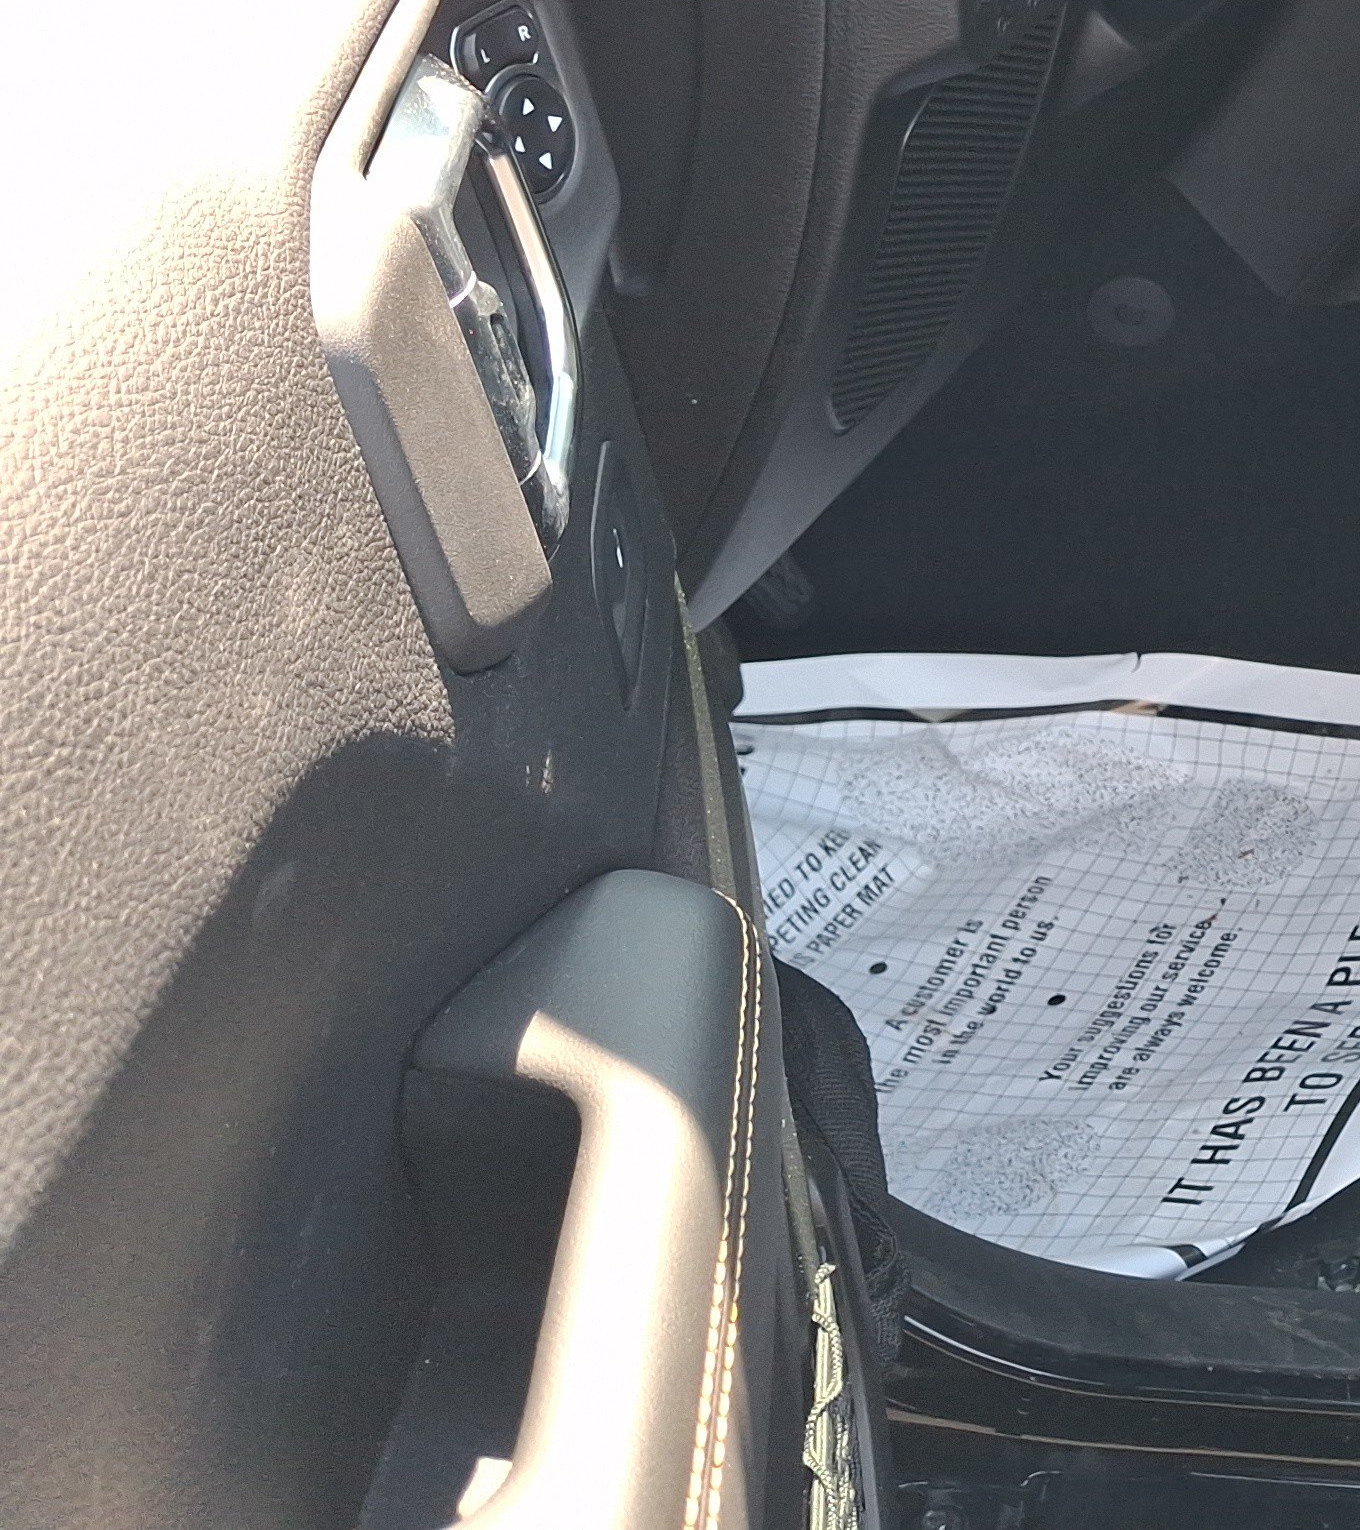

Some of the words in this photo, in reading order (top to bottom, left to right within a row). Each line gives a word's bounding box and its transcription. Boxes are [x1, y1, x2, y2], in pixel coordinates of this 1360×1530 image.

[480, 48, 491, 64] L
[517, 24, 532, 42] R
[795, 852, 823, 881] TO
[805, 903, 864, 955] PAPER
[855, 864, 895, 907] MAT
[829, 837, 883, 892] CLEAN
[885, 1018, 909, 1031] A
[901, 937, 968, 1017] customer
[956, 919, 984, 934] is
[902, 1018, 947, 1064] most
[937, 933, 1010, 1017] important
[1001, 876, 1053, 931] person
[931, 1050, 959, 1064] in
[949, 1020, 984, 1045] the
[977, 968, 1022, 1016] world
[1011, 947, 1037, 965] to
[1028, 916, 1059, 943] us.
[1038, 1047, 1083, 1082] Your
[1077, 949, 1160, 1043] suggestions
[1146, 922, 1177, 945] for
[1108, 1066, 1140, 1091] are
[1133, 1010, 1186, 1062] always
[1177, 926, 1243, 1008] welcome.
[1069, 1016, 1151, 1091] improving
[1140, 984, 1169, 1013] our
[1161, 1177, 1215, 1206] IT
[1190, 1096, 1266, 1165] HAS
[1243, 1020, 1332, 1084] BEEN
[1310, 999, 1353, 1016] A
[1283, 1071, 1344, 1113] TO
